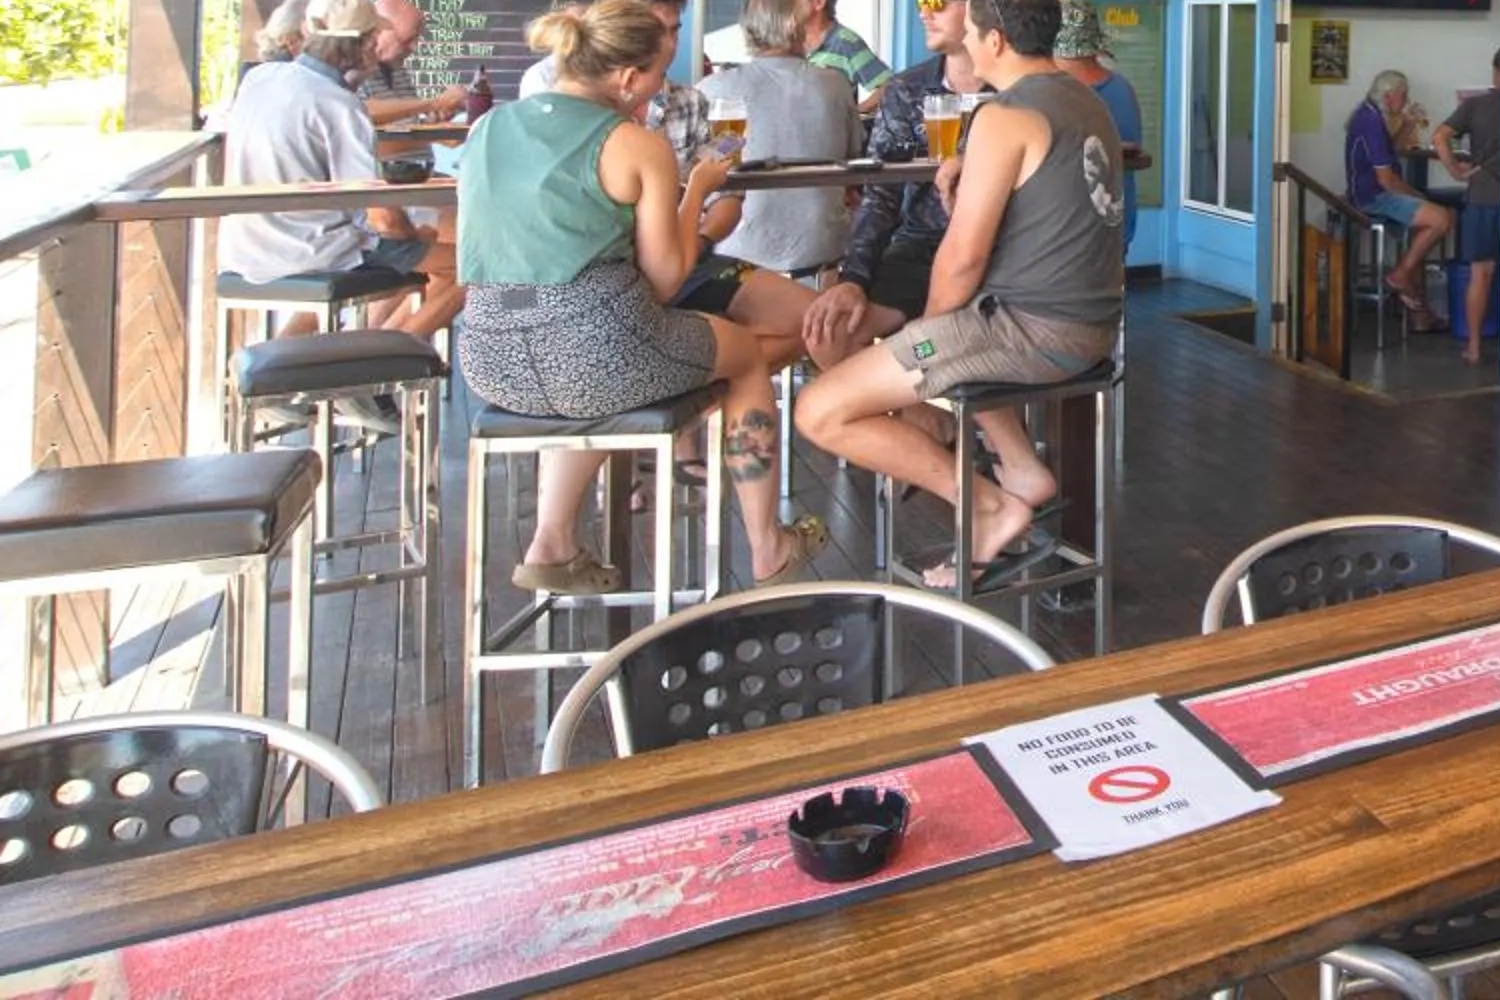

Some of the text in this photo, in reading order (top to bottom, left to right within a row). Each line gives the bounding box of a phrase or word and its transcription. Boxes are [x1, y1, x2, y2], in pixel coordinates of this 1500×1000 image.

[1017, 714, 1139, 753] NO FOOD TO BE
[1042, 730, 1137, 760] CONSUMED
[1048, 741, 1159, 776] IN THIS AREA
[1121, 799, 1190, 825] THANK YOU
